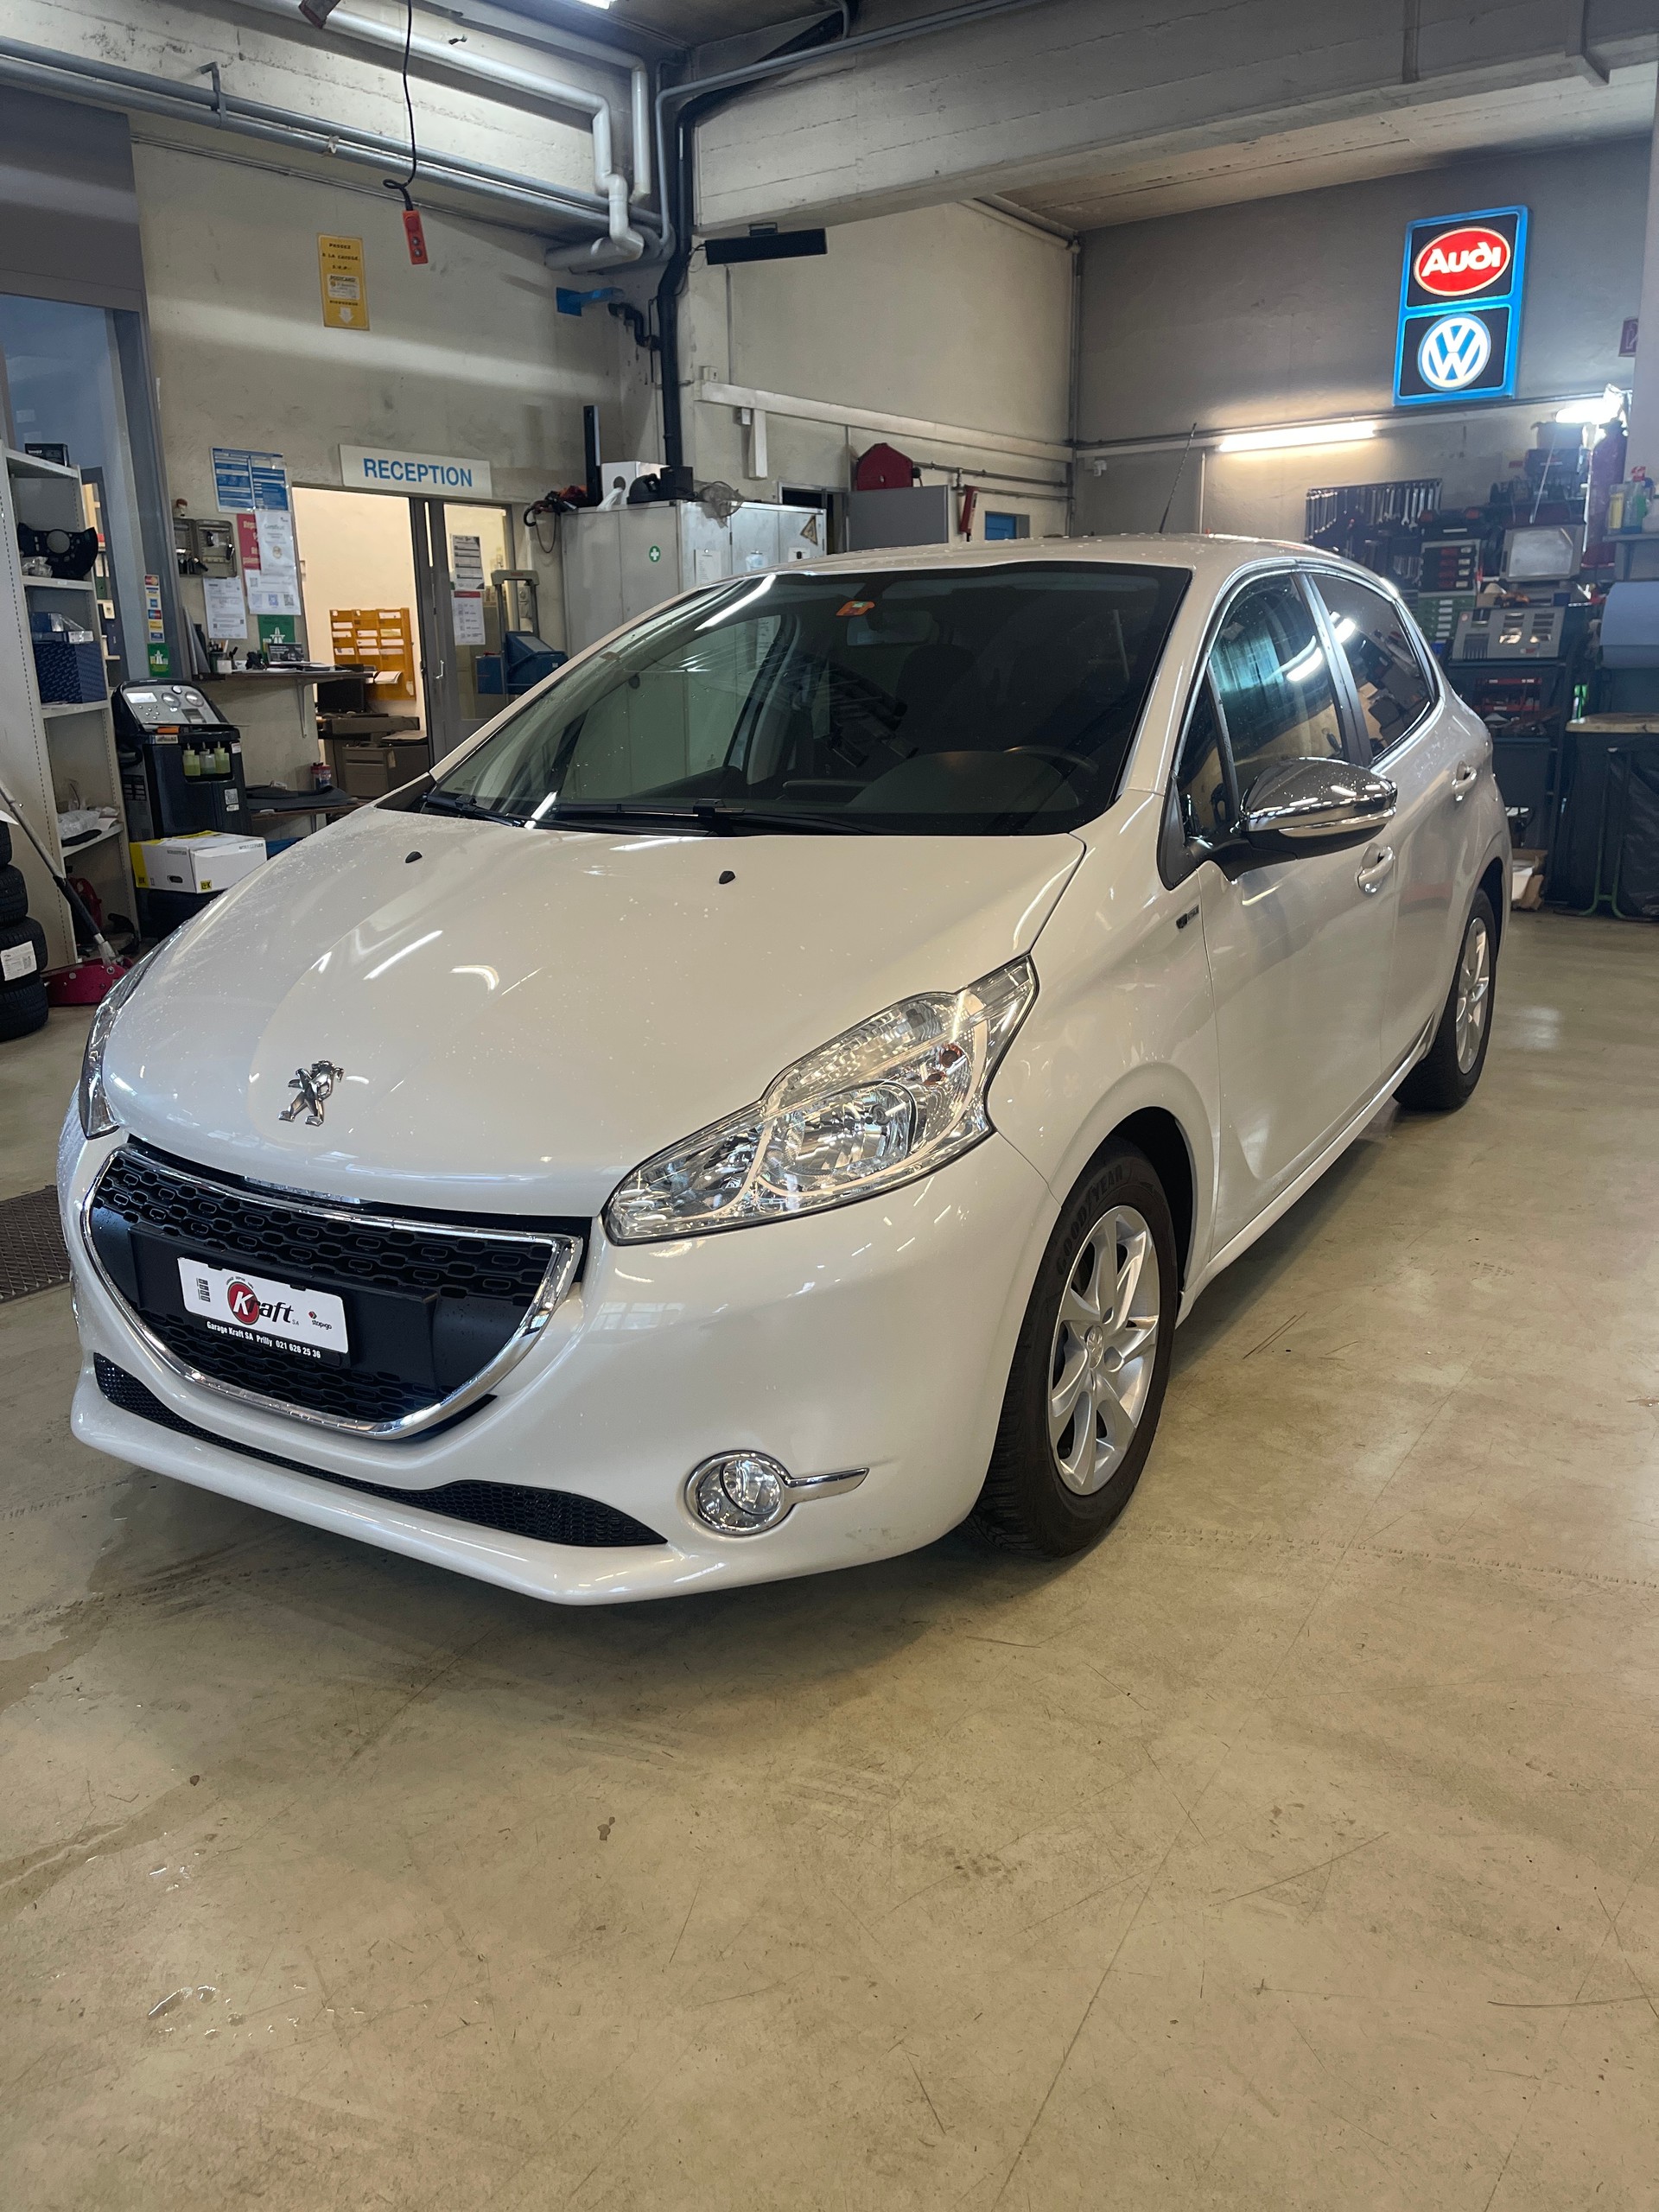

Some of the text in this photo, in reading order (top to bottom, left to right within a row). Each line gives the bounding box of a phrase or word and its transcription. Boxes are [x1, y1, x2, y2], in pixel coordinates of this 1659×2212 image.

[1421, 241, 1502, 277] Audi
[1420, 315, 1489, 389] VW
[363, 458, 473, 487] RECEPTION
[232, 1291, 295, 1324] Kraft
[207, 1320, 321, 1359] Garage Kraft SA Prilly 021 626 25 36
